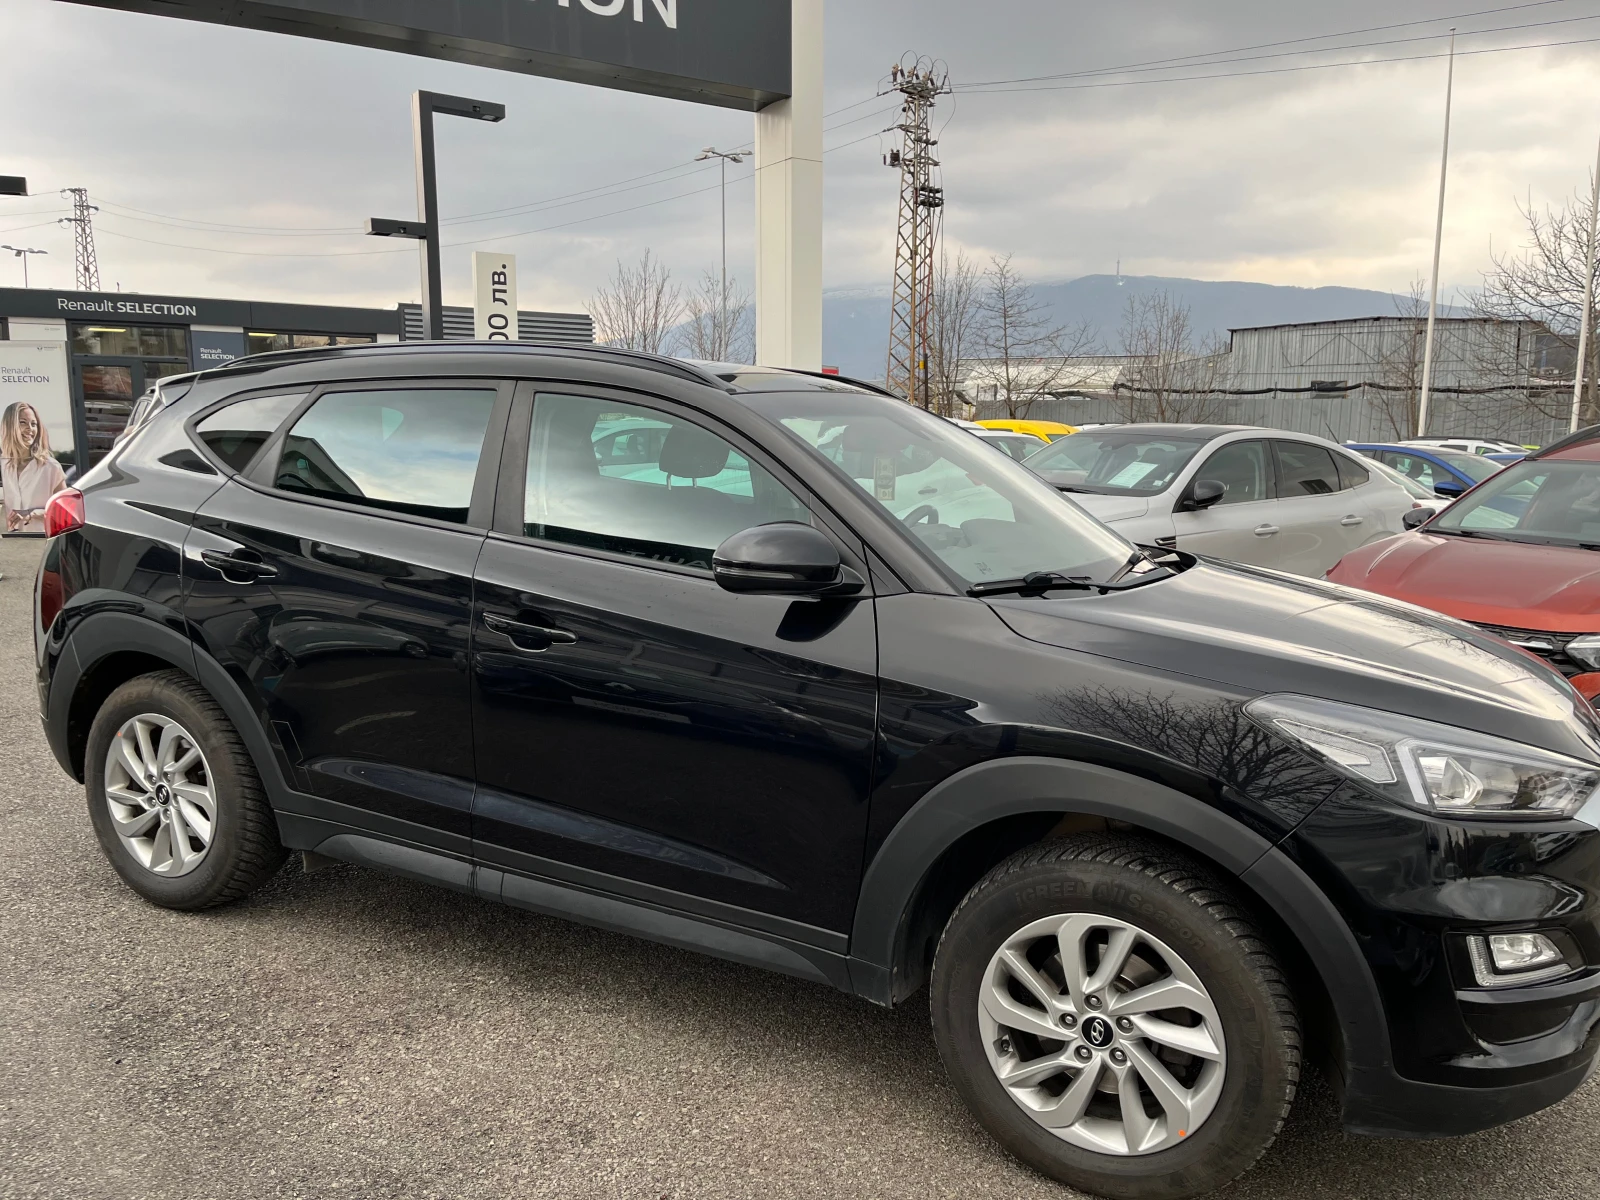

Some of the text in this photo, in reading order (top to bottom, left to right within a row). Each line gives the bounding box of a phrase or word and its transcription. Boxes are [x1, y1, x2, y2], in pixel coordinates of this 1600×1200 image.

[57, 298, 197, 317] Renault SELECTION
[1, 366, 31, 374] Renault
[2, 375, 50, 383] SELECTION
